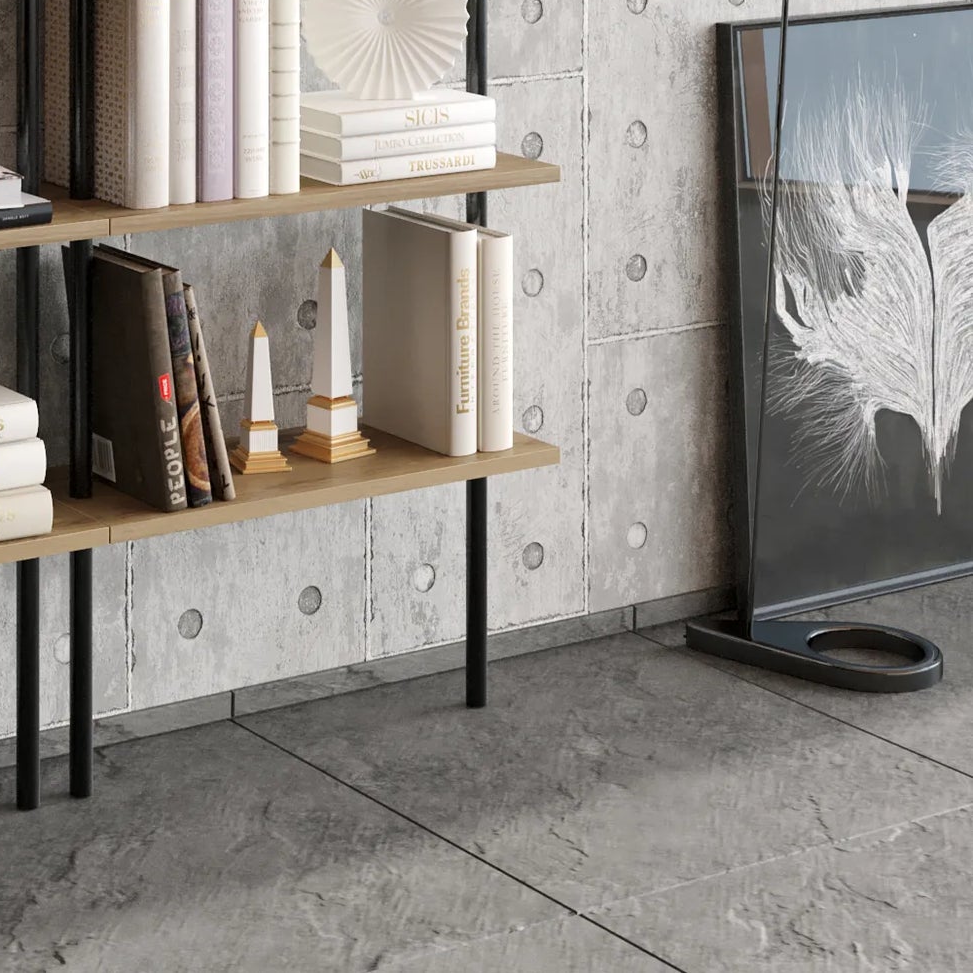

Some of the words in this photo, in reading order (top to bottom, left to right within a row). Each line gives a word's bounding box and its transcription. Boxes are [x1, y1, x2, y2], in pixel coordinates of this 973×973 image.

[404, 106, 449, 128] SICIS
[373, 138, 406, 152] JUMBO
[408, 132, 465, 147] COLLECTION
[409, 154, 475, 172] TRUSSARDI
[455, 268, 470, 331] Brands
[491, 324, 500, 350] THE
[455, 335, 470, 415] Furniture
[160, 416, 185, 505] PEOPLE
